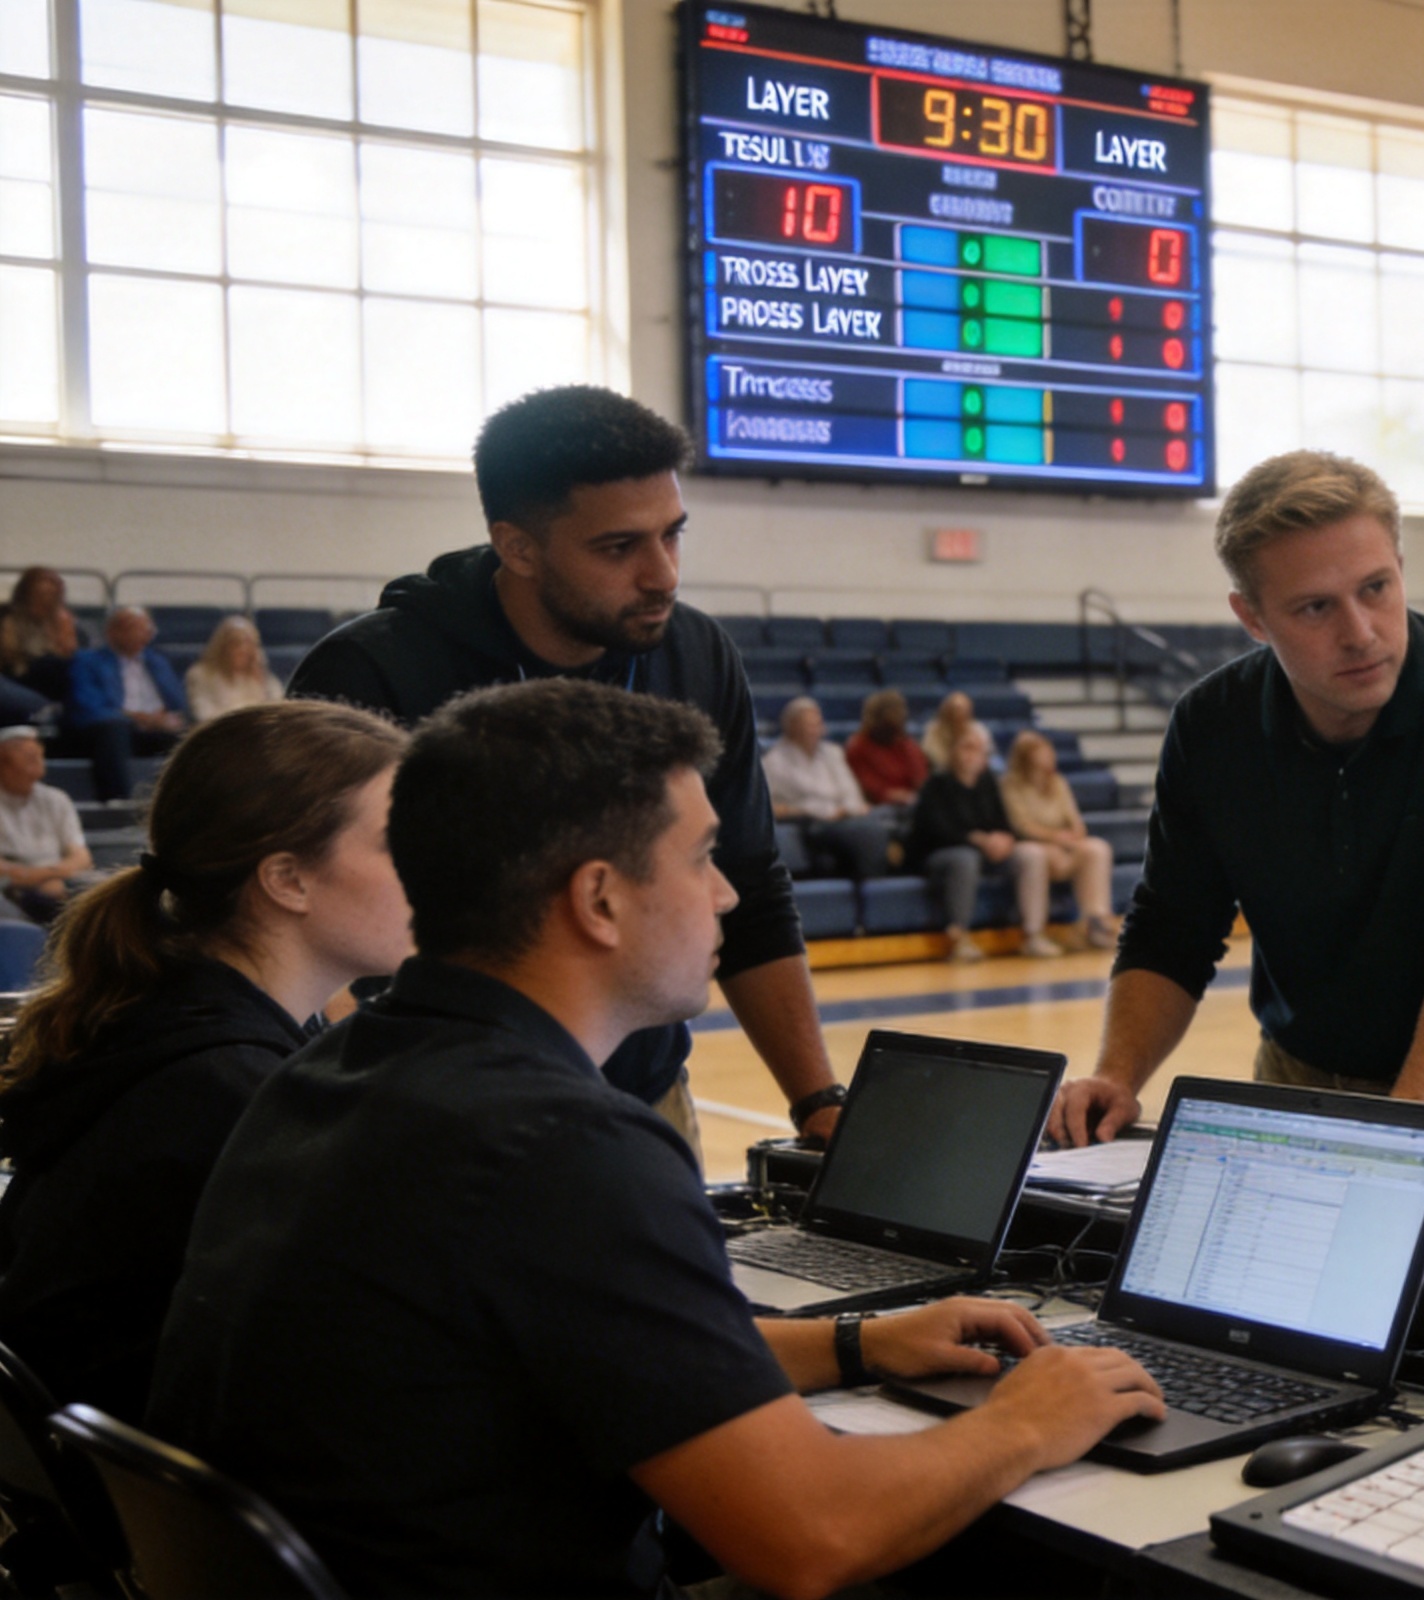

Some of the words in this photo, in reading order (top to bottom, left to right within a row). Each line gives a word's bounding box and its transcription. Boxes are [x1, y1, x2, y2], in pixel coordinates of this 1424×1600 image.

[747, 76, 829, 120] LAYER
[924, 88, 1047, 160] 9:30
[1095, 130, 1167, 172] LAYER
[783, 185, 842, 243] 10
[1149, 229, 1182, 284] 0
